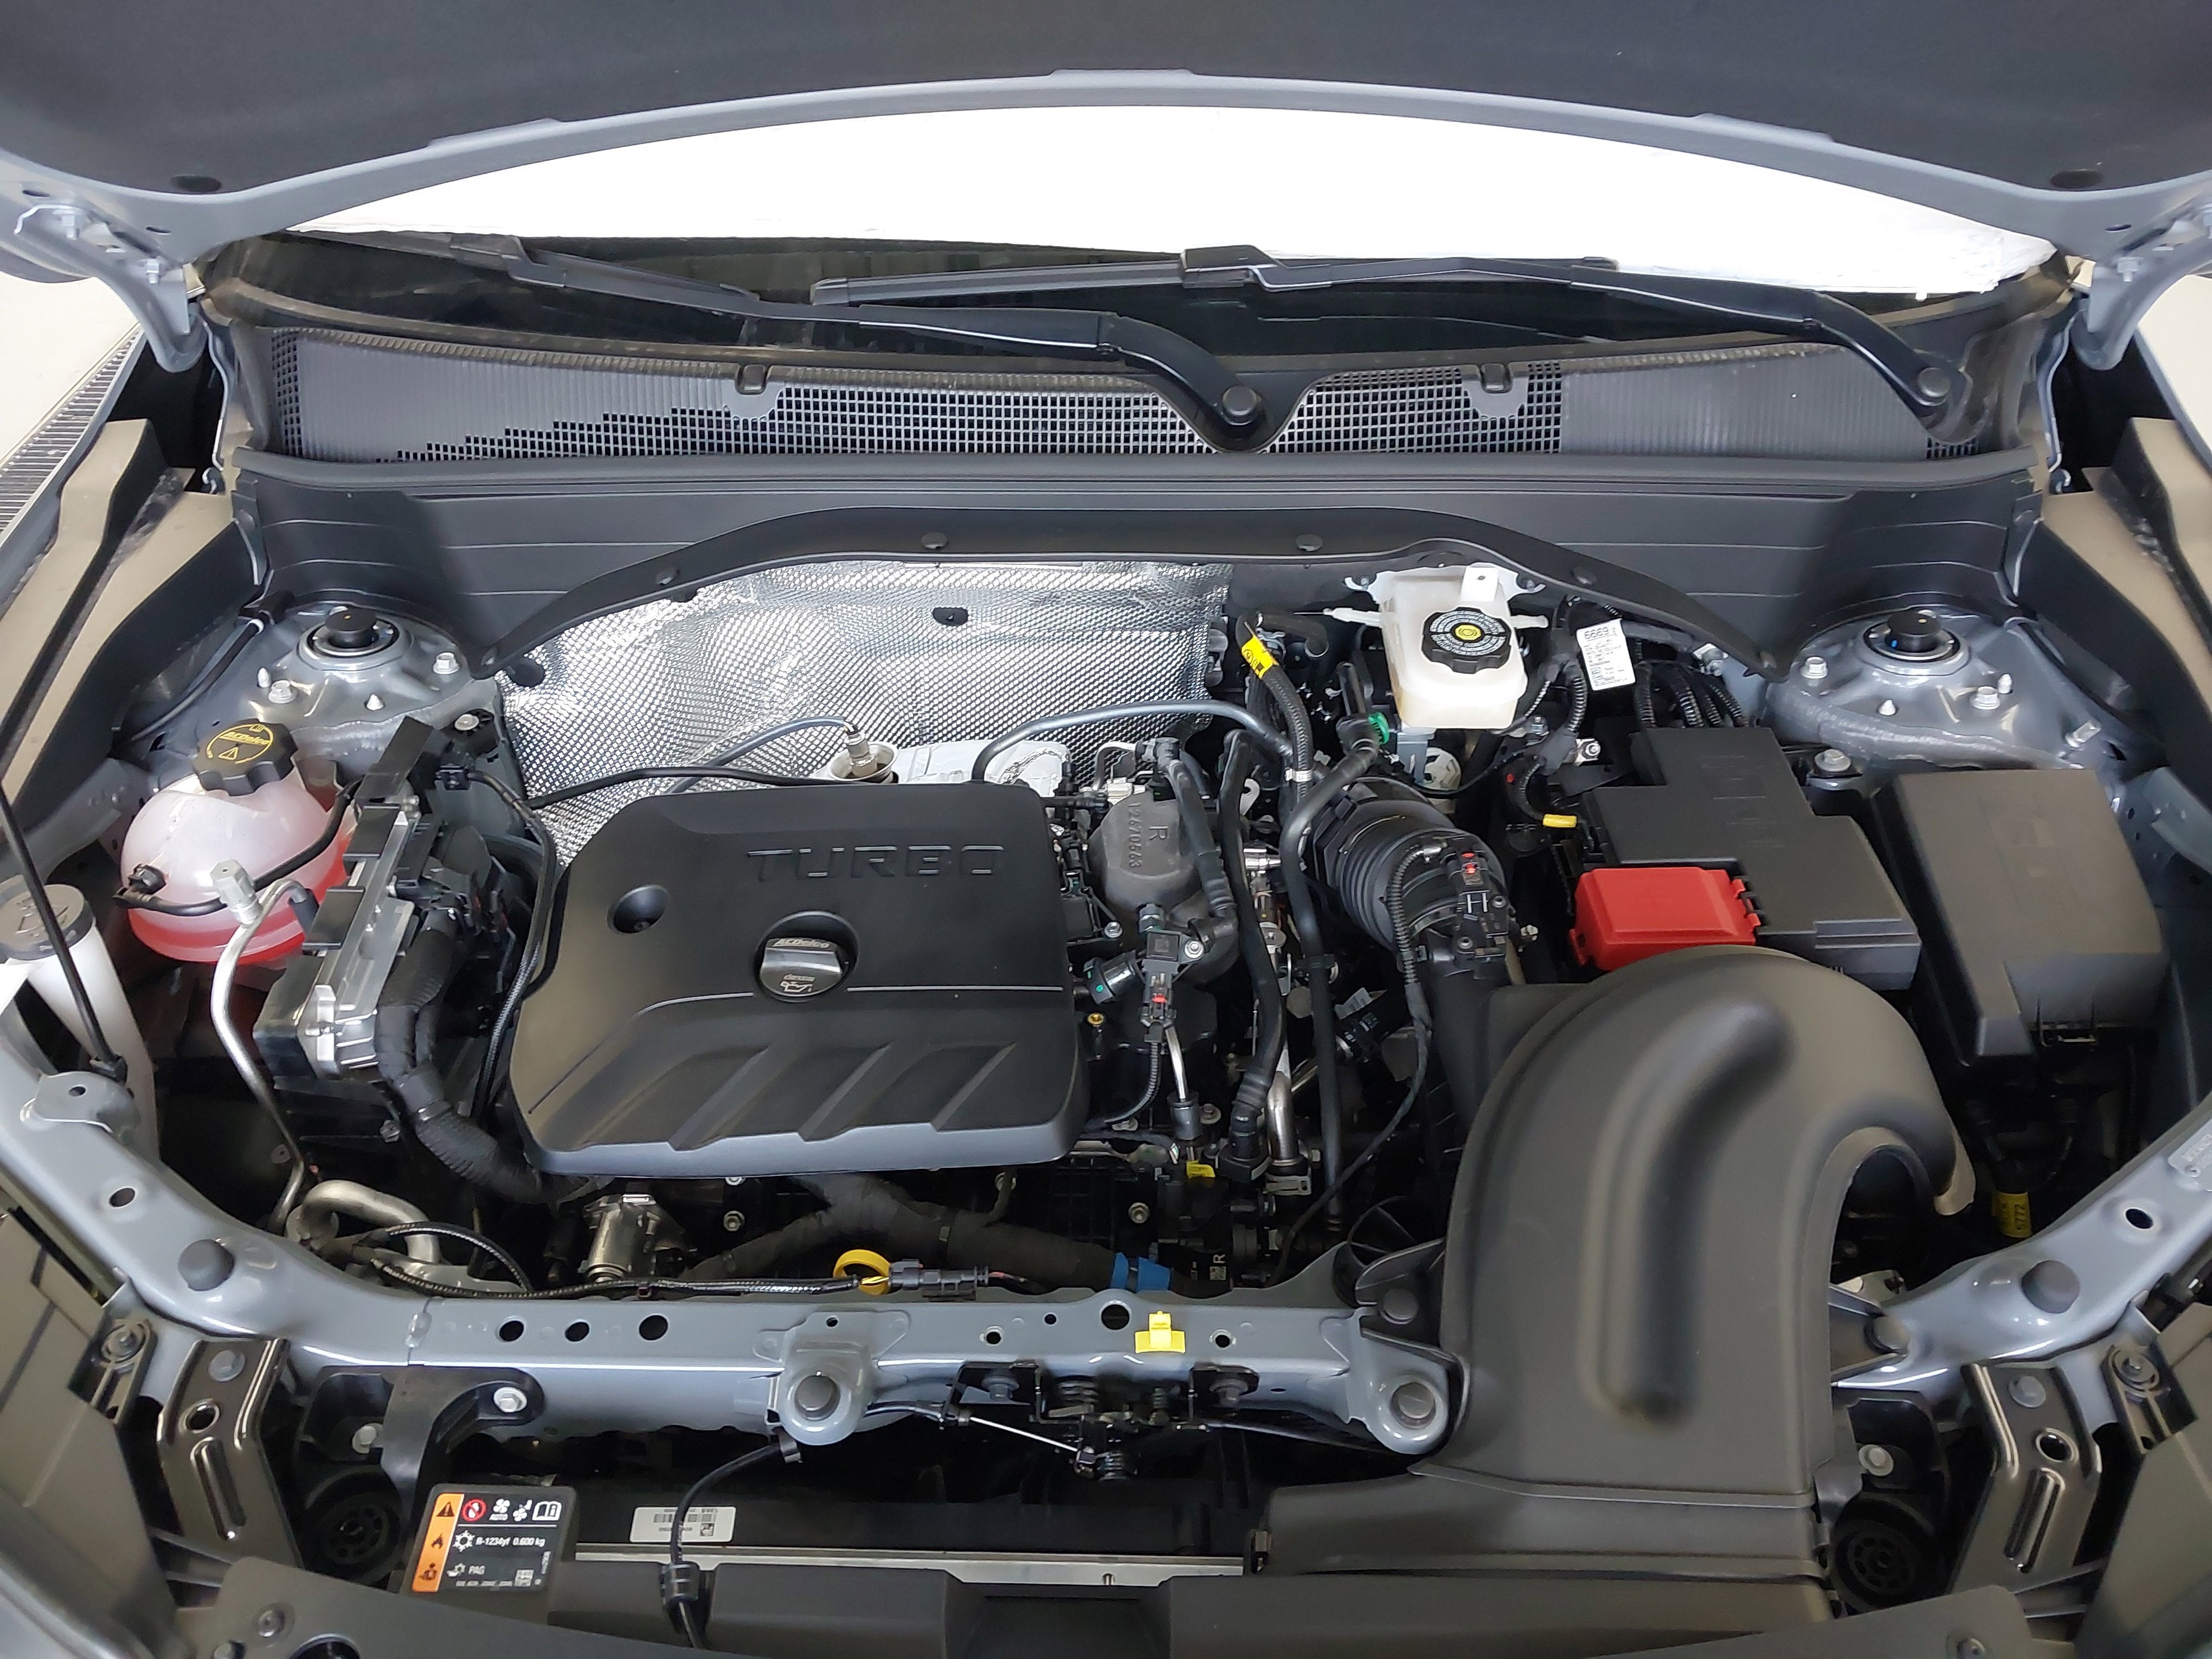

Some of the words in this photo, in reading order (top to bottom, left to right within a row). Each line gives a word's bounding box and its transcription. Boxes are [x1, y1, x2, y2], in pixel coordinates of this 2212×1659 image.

[218, 731, 271, 745] ACDelco
[1149, 825, 1168, 840] R
[747, 844, 1005, 882] TURBO
[773, 938, 831, 949] ACDelco
[1213, 1254, 1226, 1264] R
[535, 1538, 546, 1548] kg
